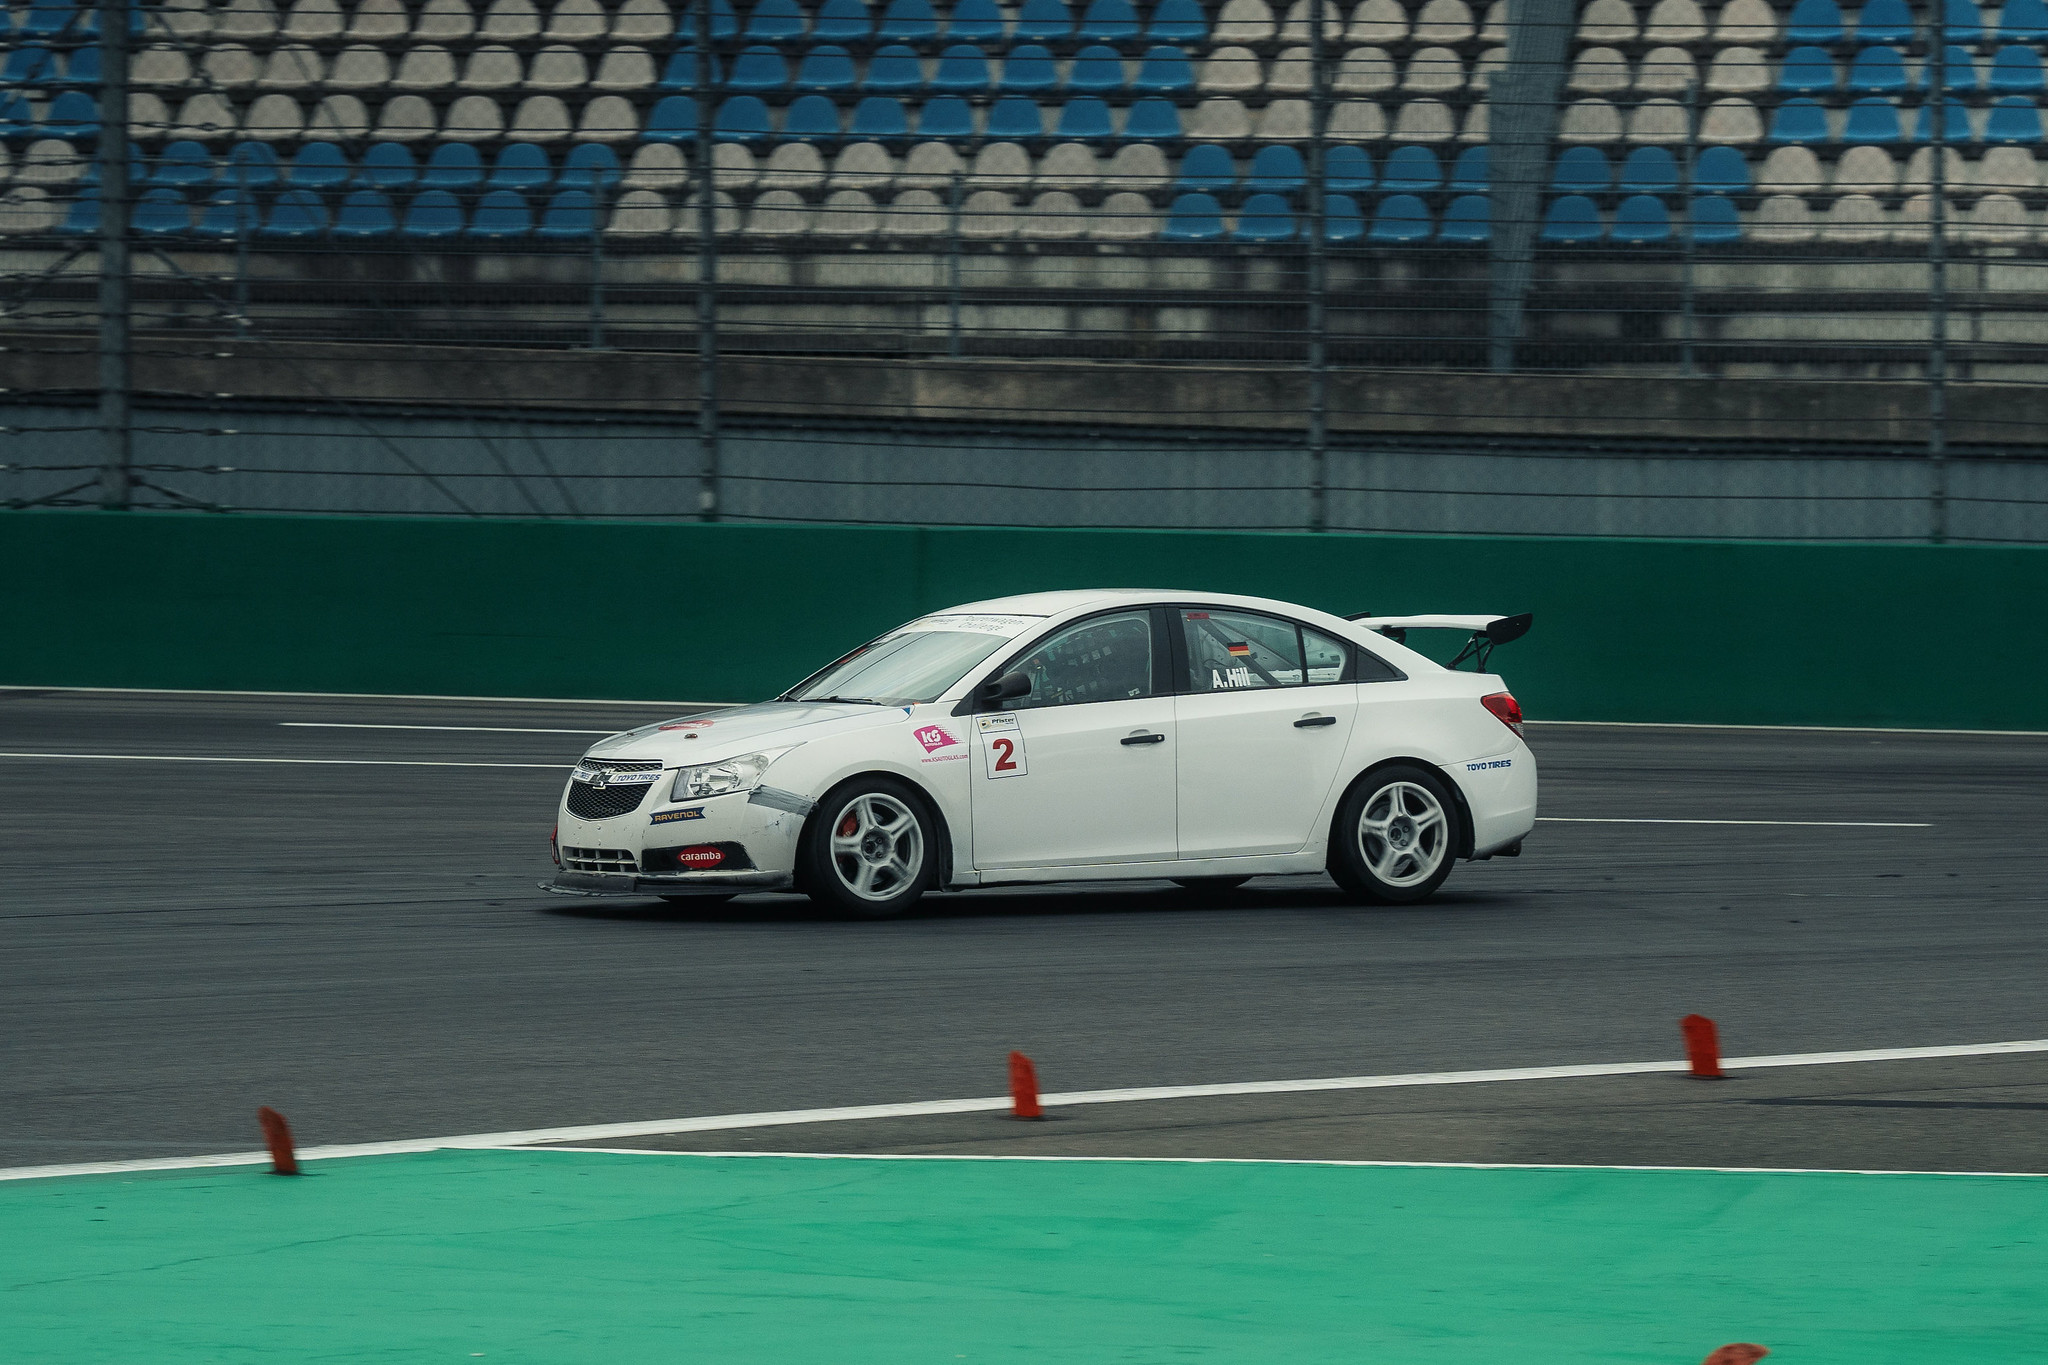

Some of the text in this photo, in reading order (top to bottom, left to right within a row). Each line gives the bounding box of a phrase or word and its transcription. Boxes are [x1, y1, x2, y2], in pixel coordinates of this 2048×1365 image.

[1212, 667, 1251, 689] A.Hill
[993, 738, 1017, 771] 2
[1466, 759, 1512, 771] TOYO TIRES
[616, 774, 638, 782] TOYO
[654, 810, 700, 822] RAVENOL
[680, 851, 721, 861] caramba
